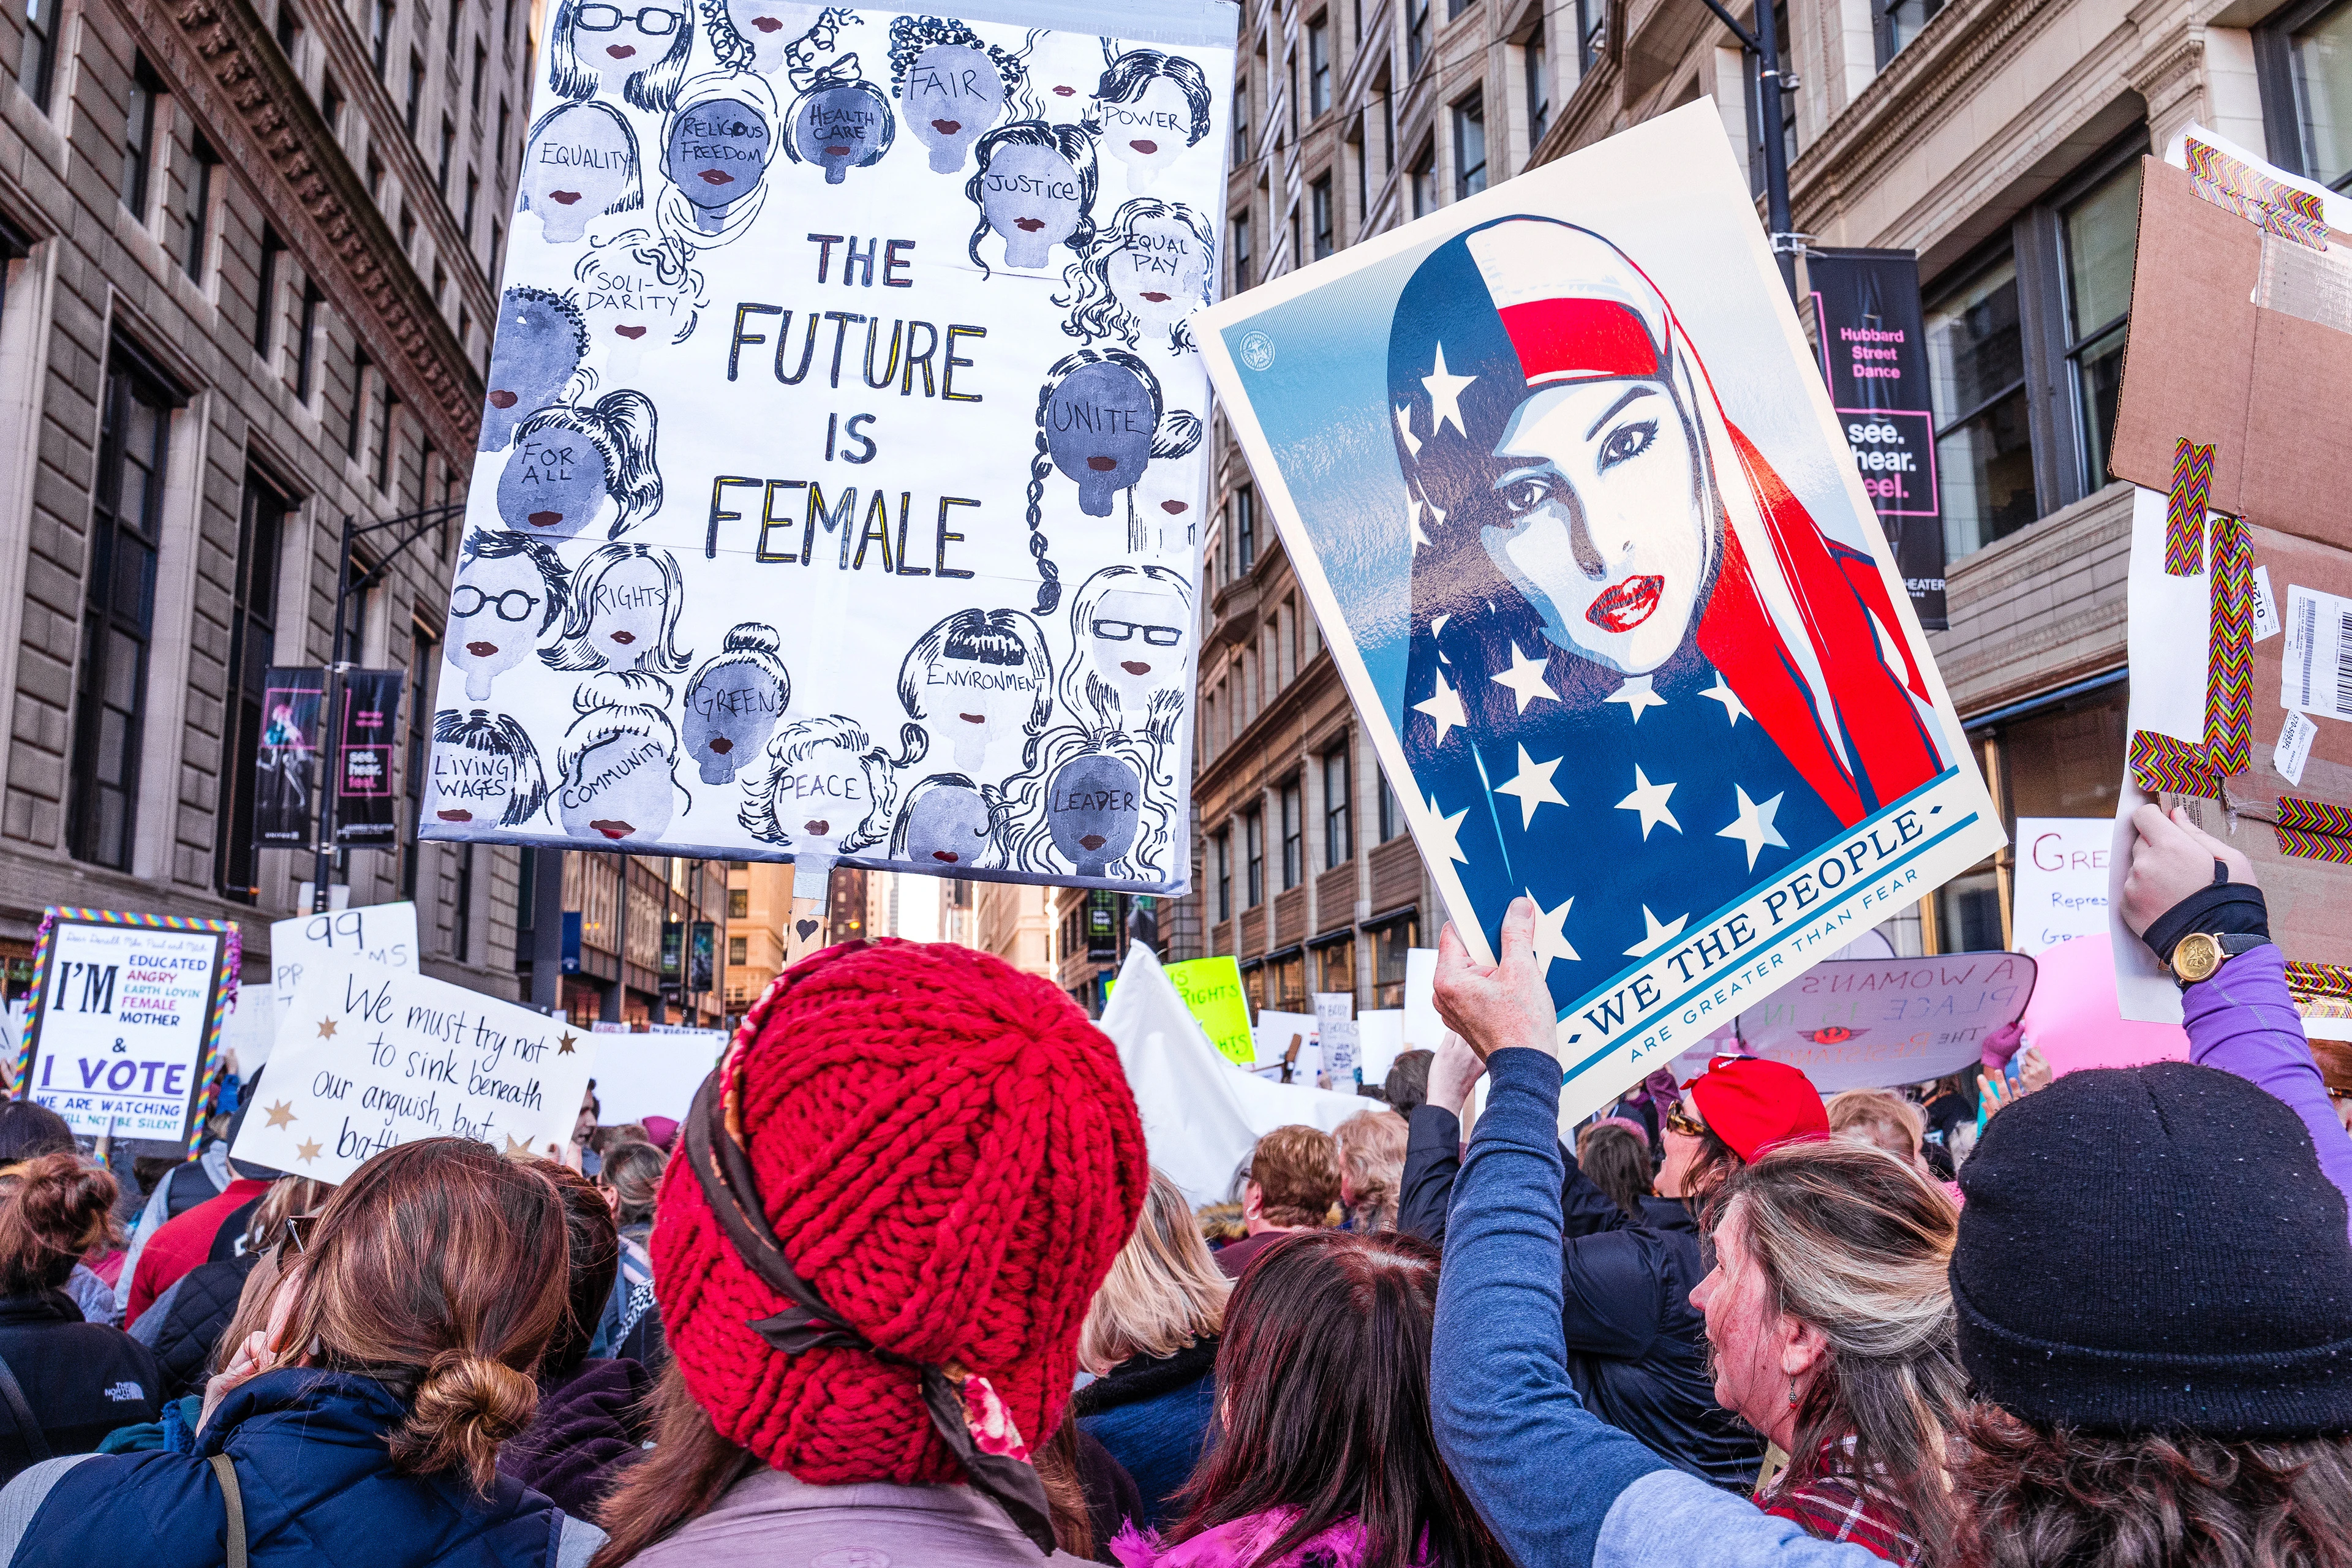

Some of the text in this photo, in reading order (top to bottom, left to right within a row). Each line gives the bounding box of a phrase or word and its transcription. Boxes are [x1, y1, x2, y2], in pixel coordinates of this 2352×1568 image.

[910, 66, 987, 101] FAIR
[810, 104, 874, 126] HEALTH
[1104, 105, 1189, 134] POWER
[813, 124, 866, 140] CARE
[540, 142, 628, 176] EQUALITY
[680, 140, 762, 164] FREEDOM
[1124, 233, 1189, 255] EQUAL
[807, 233, 916, 288] THE
[1132, 254, 1178, 276] PAY
[586, 292, 678, 316] DARITY
[1840, 326, 1905, 343] Hubbard
[727, 302, 987, 402] FUTURE
[1851, 345, 1898, 361] Street
[1852, 363, 1901, 380] Dance
[1053, 399, 1148, 435] UNITE
[824, 412, 877, 464] IS
[1848, 423, 1905, 445] see.
[521, 442, 575, 466] FOR
[1850, 445, 1917, 472] hear.
[521, 465, 573, 484] ALL
[1862, 473, 1910, 499] eel.
[706, 475, 982, 579] FEMALE
[1902, 578, 1946, 591] HEATER
[595, 584, 667, 616] RIGHTS
[693, 685, 776, 722] GREEN
[434, 754, 508, 781] LIVING
[563, 741, 664, 809] COMMUNITY
[435, 778, 507, 801] WAGES
[779, 774, 861, 804] PEACE
[1053, 790, 1138, 814] LEADER
[2033, 833, 2108, 872] GRE
[2052, 892, 2109, 911] Repres
[1583, 809, 1924, 1036] WE THE PEOPLE
[129, 954, 208, 971] EDUCATED
[1631, 869, 1918, 1063] ARE GREATER THAN FEAR
[53, 961, 119, 1014] I'M
[124, 984, 160, 995] EARTH
[127, 970, 178, 984] ANGRY
[122, 996, 177, 1011] FEMALE
[119, 1012, 180, 1027] MOTHER
[345, 973, 549, 1072] We must try not
[41, 1055, 187, 1095] I VOTE
[368, 1031, 542, 1111] to sink beneath
[36, 1096, 181, 1117] WE ARE WATCHING
[362, 1091, 442, 1131] anguish,
[453, 1102, 494, 1141] but
[87, 1115, 108, 1126] NOT
[118, 1117, 132, 1128] BE
[137, 1118, 179, 1130] SILENT
